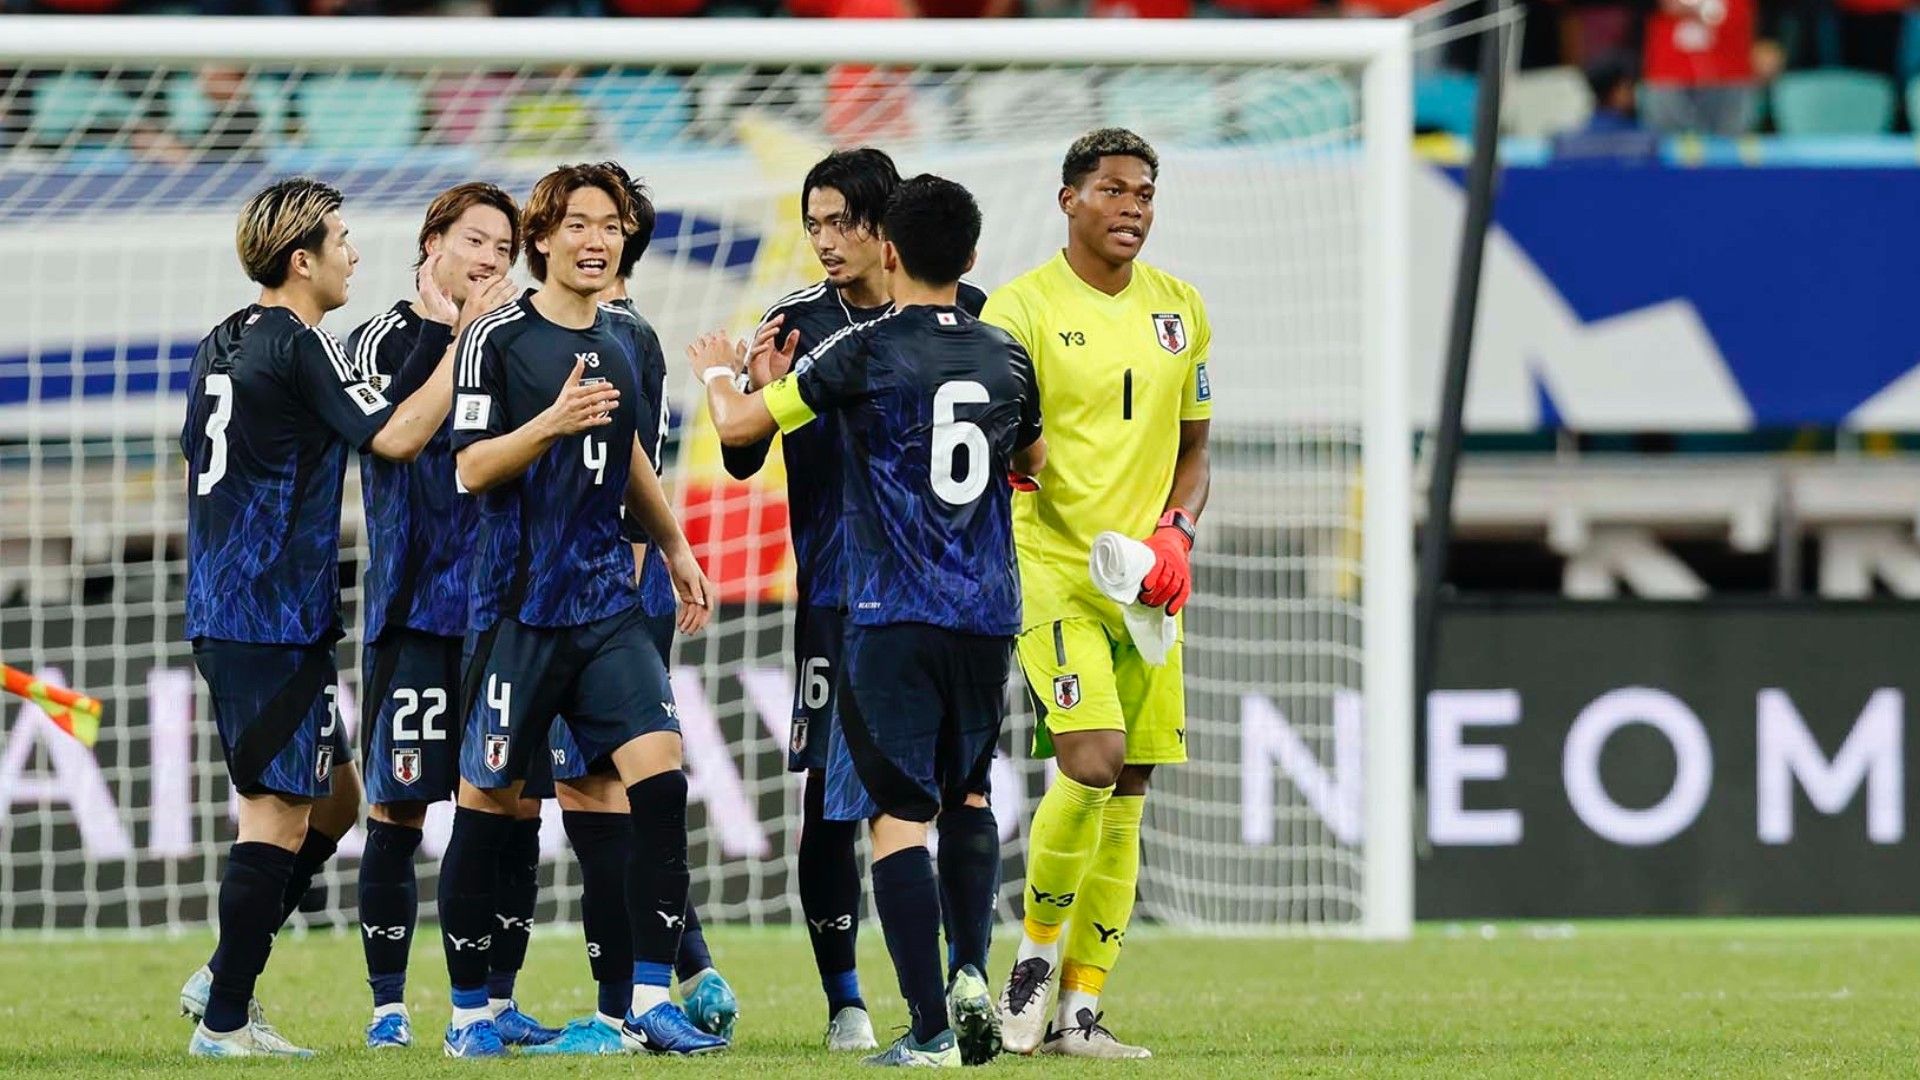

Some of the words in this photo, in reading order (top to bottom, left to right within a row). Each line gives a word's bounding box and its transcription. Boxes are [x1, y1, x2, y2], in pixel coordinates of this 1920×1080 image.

[1058, 331, 1086, 346] Y-3
[1123, 368, 1132, 420] 1
[197, 374, 233, 495] 3
[583, 434, 607, 485] 4
[930, 380, 991, 505] 6
[487, 672, 512, 727] 4
[798, 657, 830, 709] 16
[320, 684, 338, 736] 3
[392, 688, 448, 741] 22
[551, 748, 566, 766] Y-3
[1241, 687, 1906, 845] NEOM
[1031, 884, 1075, 907] Y-3
[362, 923, 406, 940] Y-3
[447, 932, 492, 951] Y-3
[810, 913, 852, 933] Y-3
